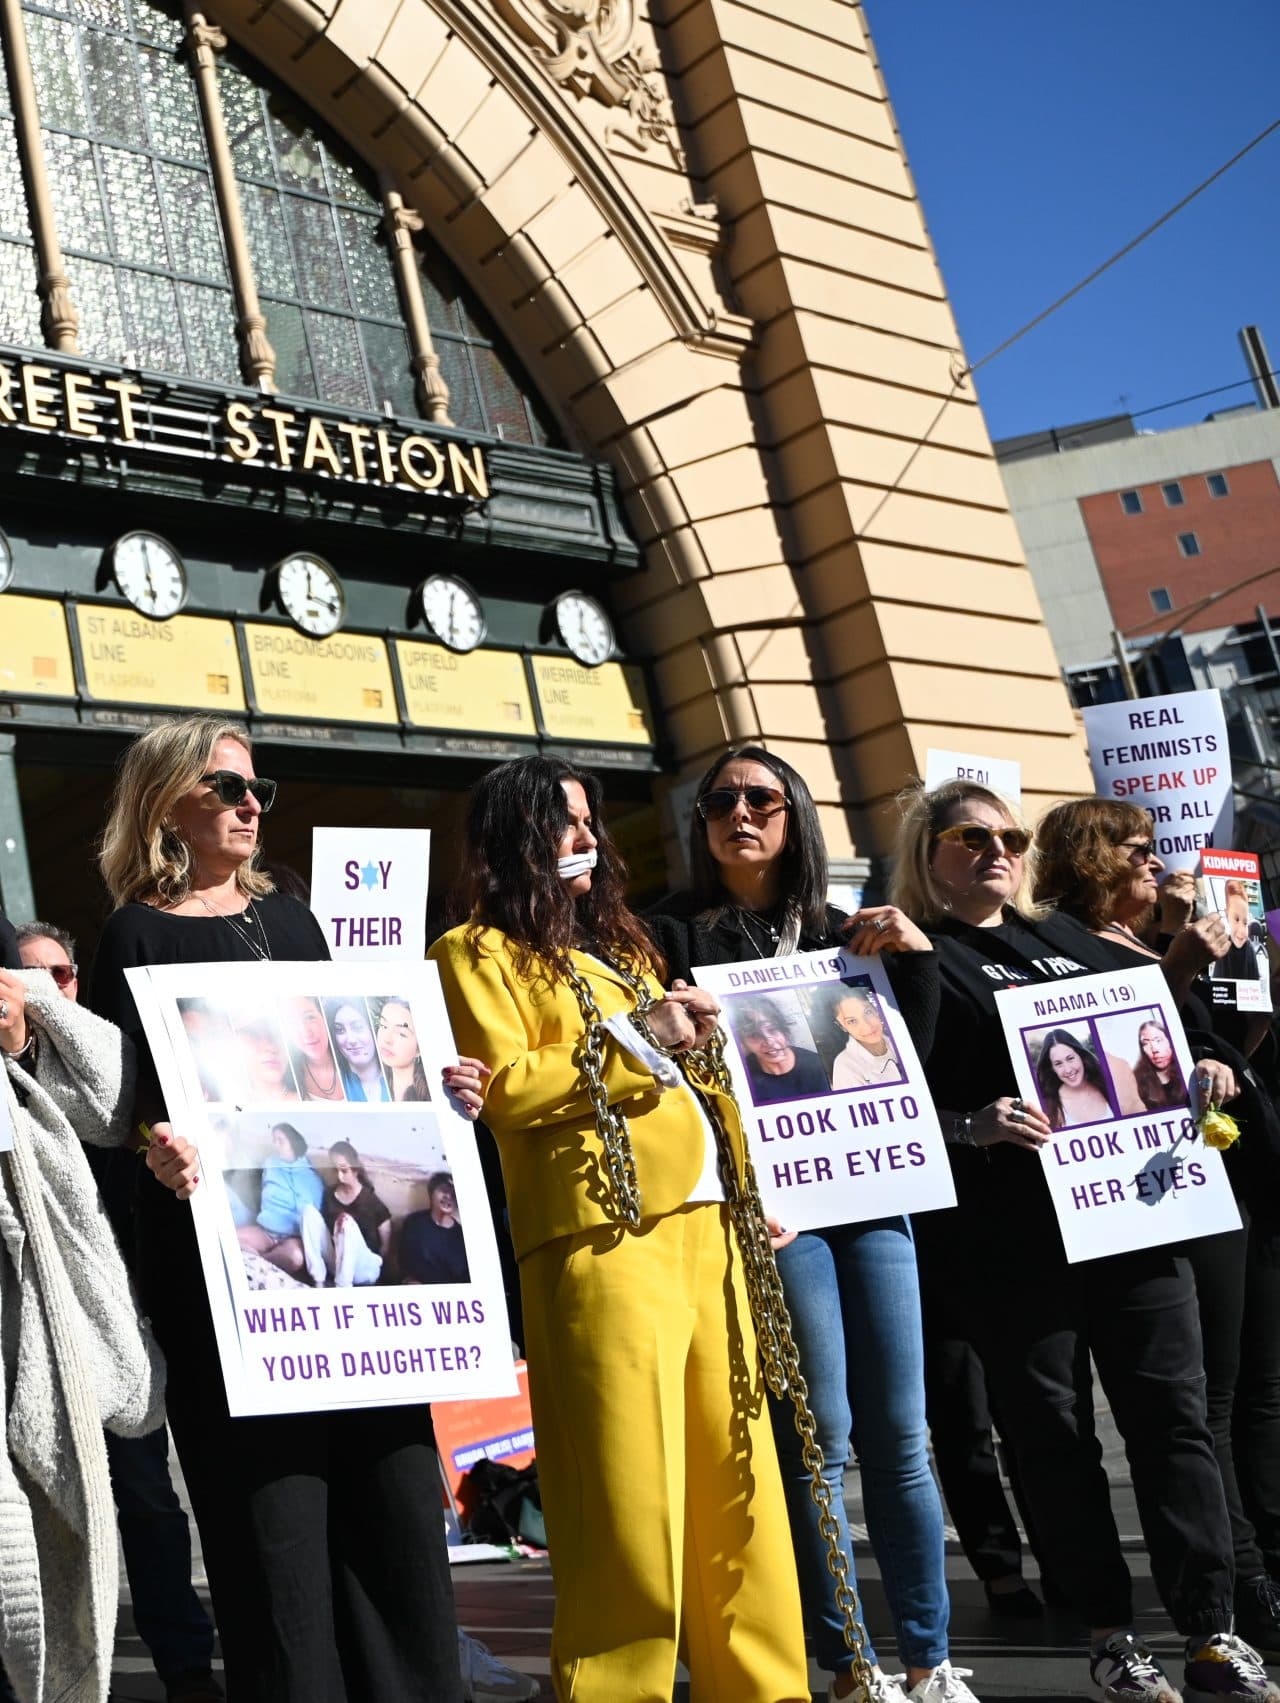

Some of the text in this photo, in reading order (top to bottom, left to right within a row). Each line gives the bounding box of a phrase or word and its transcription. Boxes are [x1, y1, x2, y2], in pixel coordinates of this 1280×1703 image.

[227, 402, 490, 498] STATION
[88, 616, 173, 642] ST ALBANS
[90, 642, 126, 663] LINE
[254, 635, 377, 662] BROADMEADOWS
[404, 652, 458, 671] UPFIELD
[258, 659, 291, 679] LINE
[408, 674, 438, 692] LINE
[540, 667, 601, 686] WERRIBEE
[544, 689, 570, 705] LINE
[1128, 707, 1184, 730] REAL
[1102, 735, 1217, 766] FEMINISTS
[1113, 767, 1218, 797] SPEAK UP
[1181, 800, 1214, 820] ALL
[1153, 831, 1214, 856] OMEN
[1203, 856, 1257, 873] KIDNAPPED
[331, 917, 402, 947] THEIR
[728, 957, 848, 987] DANIELA (19)
[1034, 983, 1137, 1017] NAAMA (19)
[757, 1095, 920, 1143] LOOK INTO
[1053, 1117, 1199, 1166] LOOK INTO
[772, 1141, 927, 1189] HER EYES
[1070, 1162, 1207, 1210] HER EYES
[243, 1299, 486, 1334] WHAT IF THIS WAS
[262, 1344, 482, 1382] YOUR DAUGHTER?
